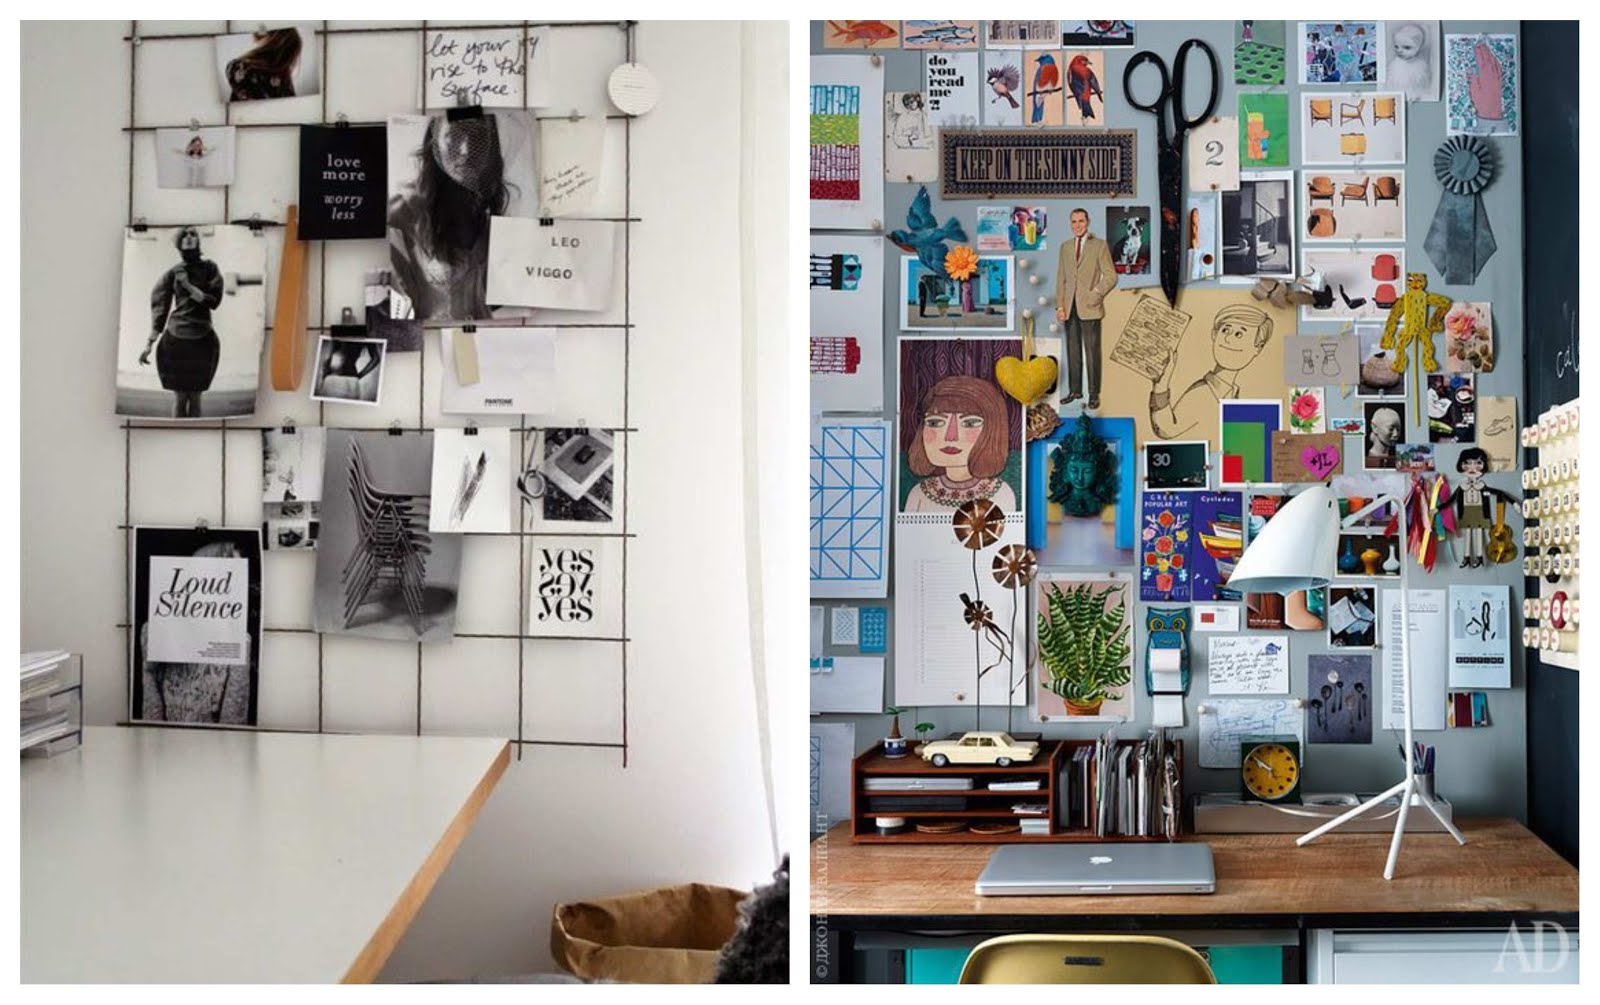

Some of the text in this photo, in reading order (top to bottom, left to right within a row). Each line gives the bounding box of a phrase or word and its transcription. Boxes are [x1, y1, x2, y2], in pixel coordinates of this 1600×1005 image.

[426, 34, 458, 57] let
[462, 39, 510, 65] your
[929, 55, 947, 66] do
[430, 64, 464, 81] rise
[473, 60, 488, 75] to
[929, 68, 956, 78] you
[929, 76, 964, 87] read
[929, 89, 952, 97] me
[327, 153, 361, 168] love
[1205, 141, 1224, 166] 2
[960, 148, 1117, 180] KEEP ON THE SUNNY SIDE
[322, 170, 366, 181] more
[323, 195, 364, 209] worry
[331, 207, 356, 220] less
[551, 237, 581, 248] LEO
[526, 267, 573, 280] VIGGO
[1152, 453, 1171, 467] 30
[539, 549, 595, 574] yes
[168, 568, 232, 595] Loud
[153, 592, 243, 620] Silence
[538, 596, 594, 623] yes
